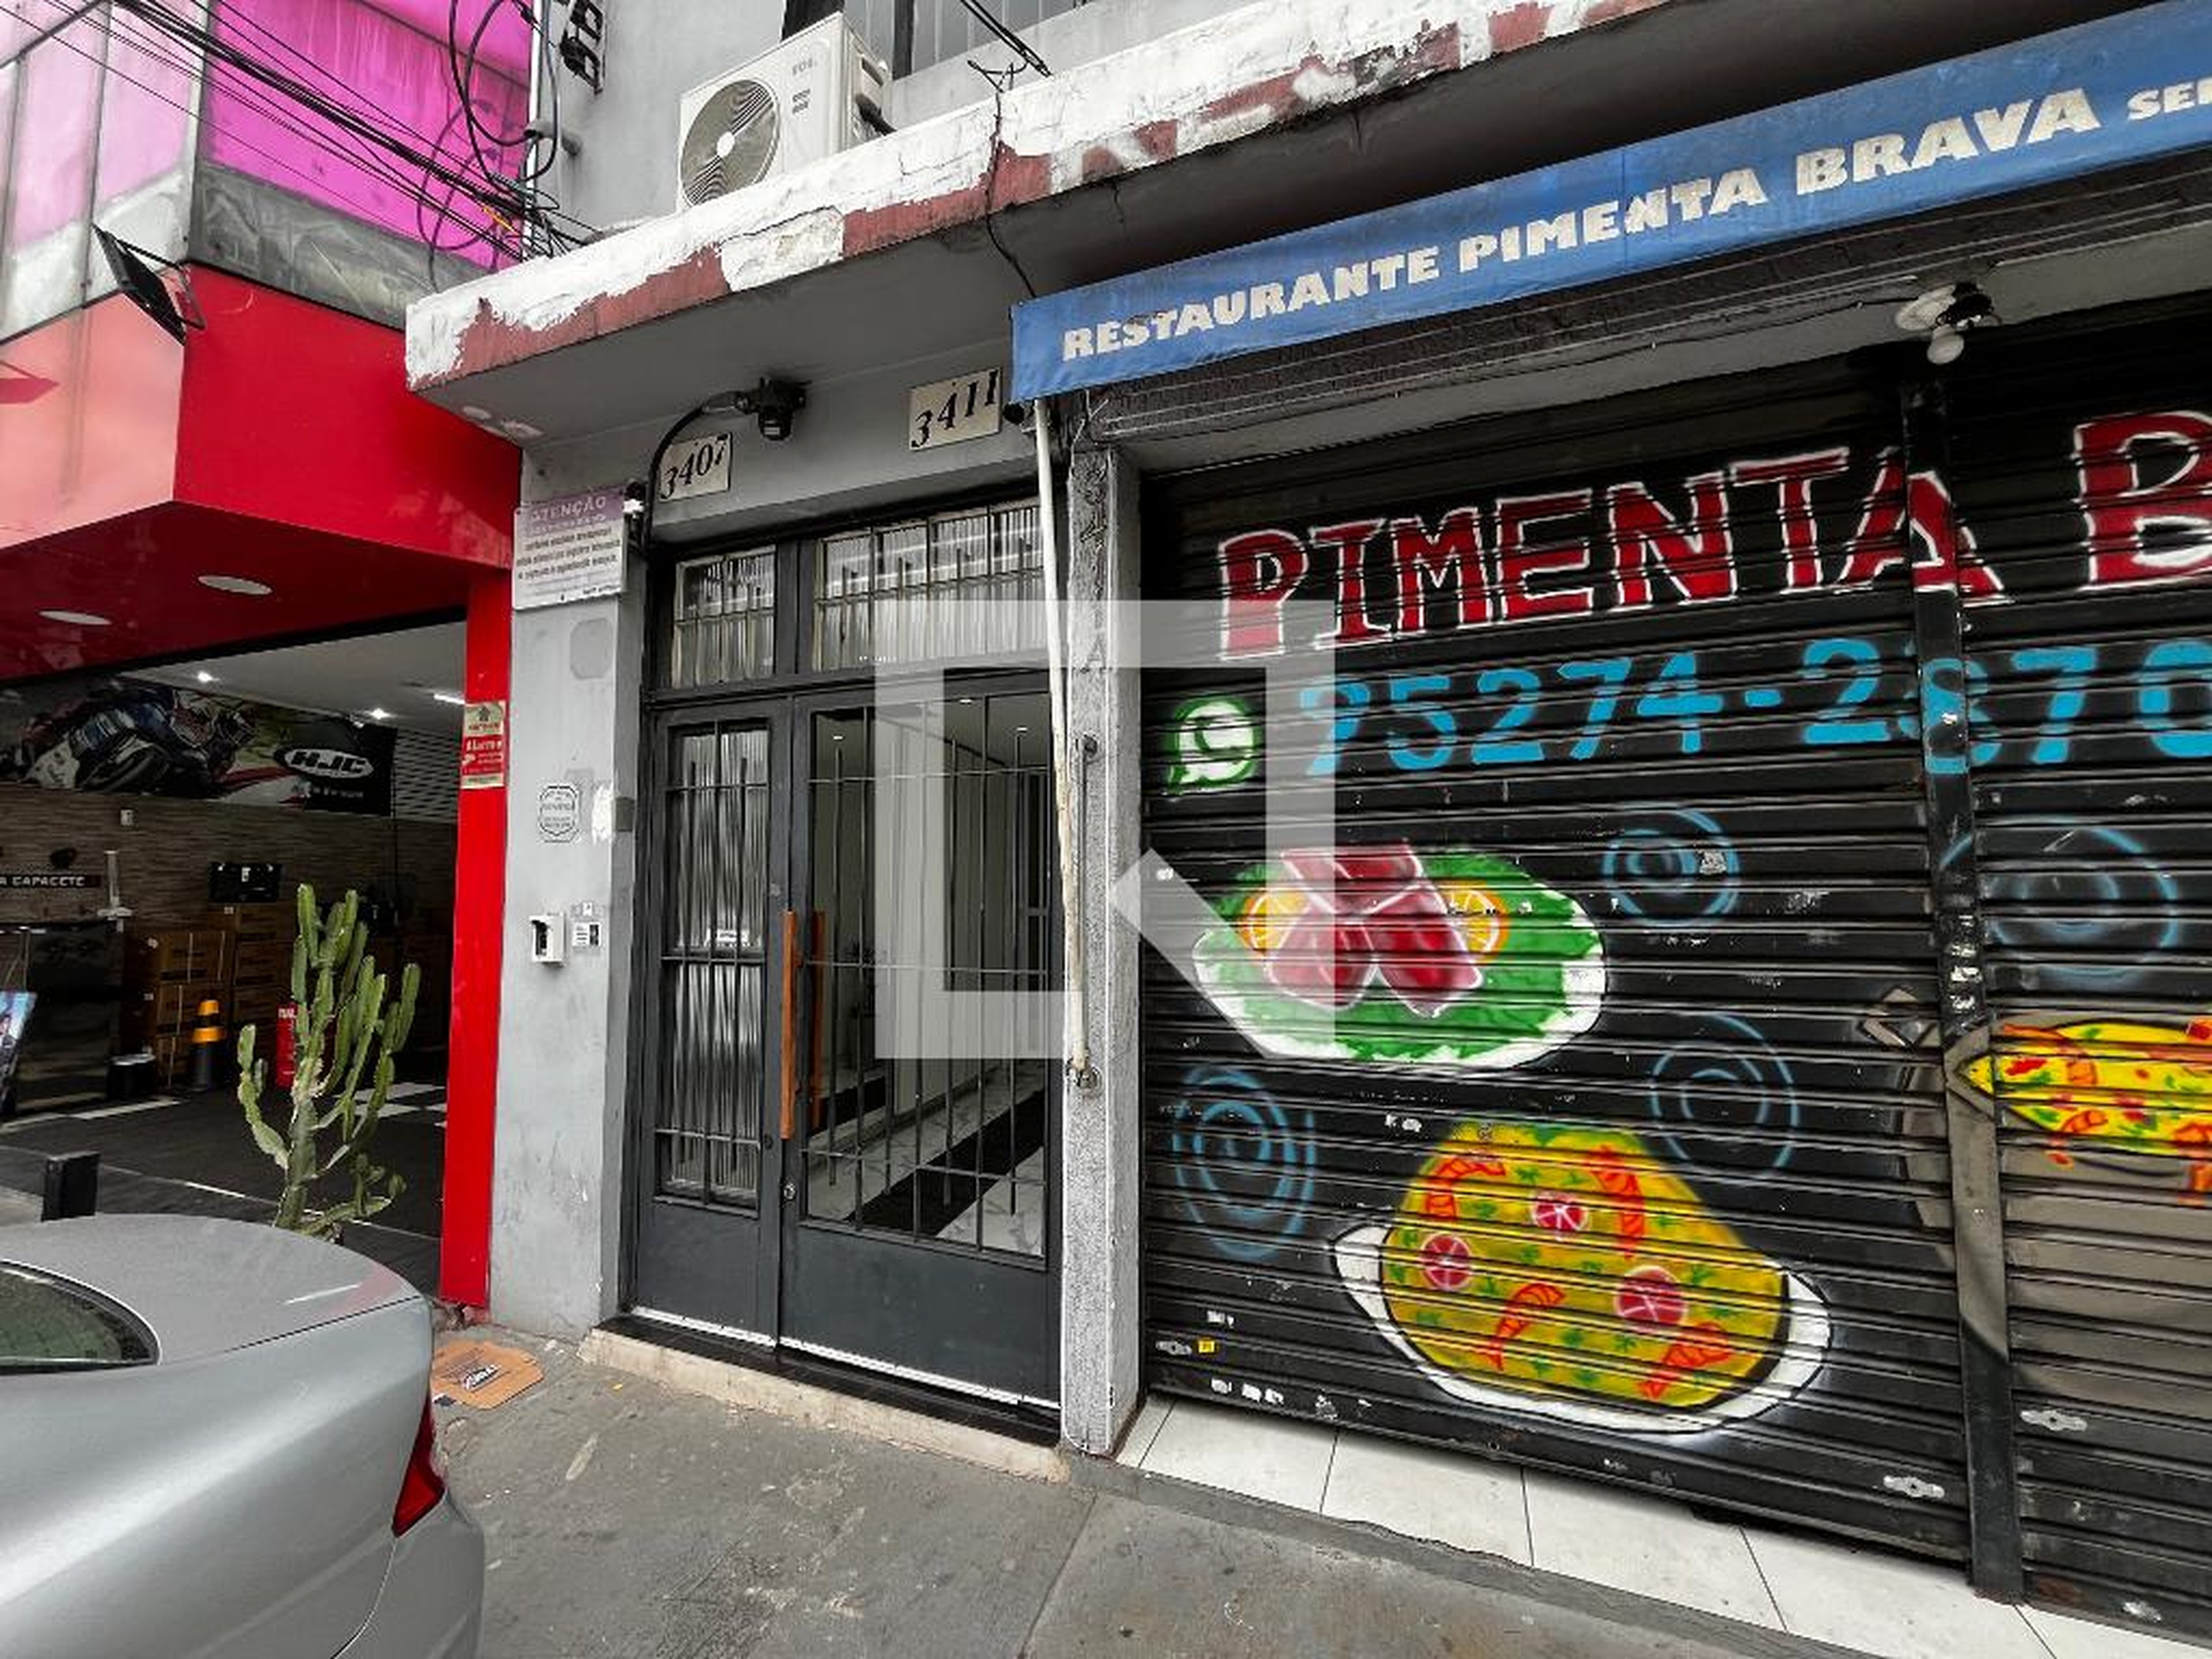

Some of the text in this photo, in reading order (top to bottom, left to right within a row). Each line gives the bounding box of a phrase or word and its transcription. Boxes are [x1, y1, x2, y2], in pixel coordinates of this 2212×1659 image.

[1062, 244, 1440, 362] RESTAURANTE
[1459, 168, 1768, 274] PIMENTA
[1796, 88, 2103, 195] BRAVA
[911, 369, 999, 448] 3411
[660, 433, 729, 499] 3407
[1217, 446, 2014, 660] PIMENTA
[290, 751, 367, 774] HJC
